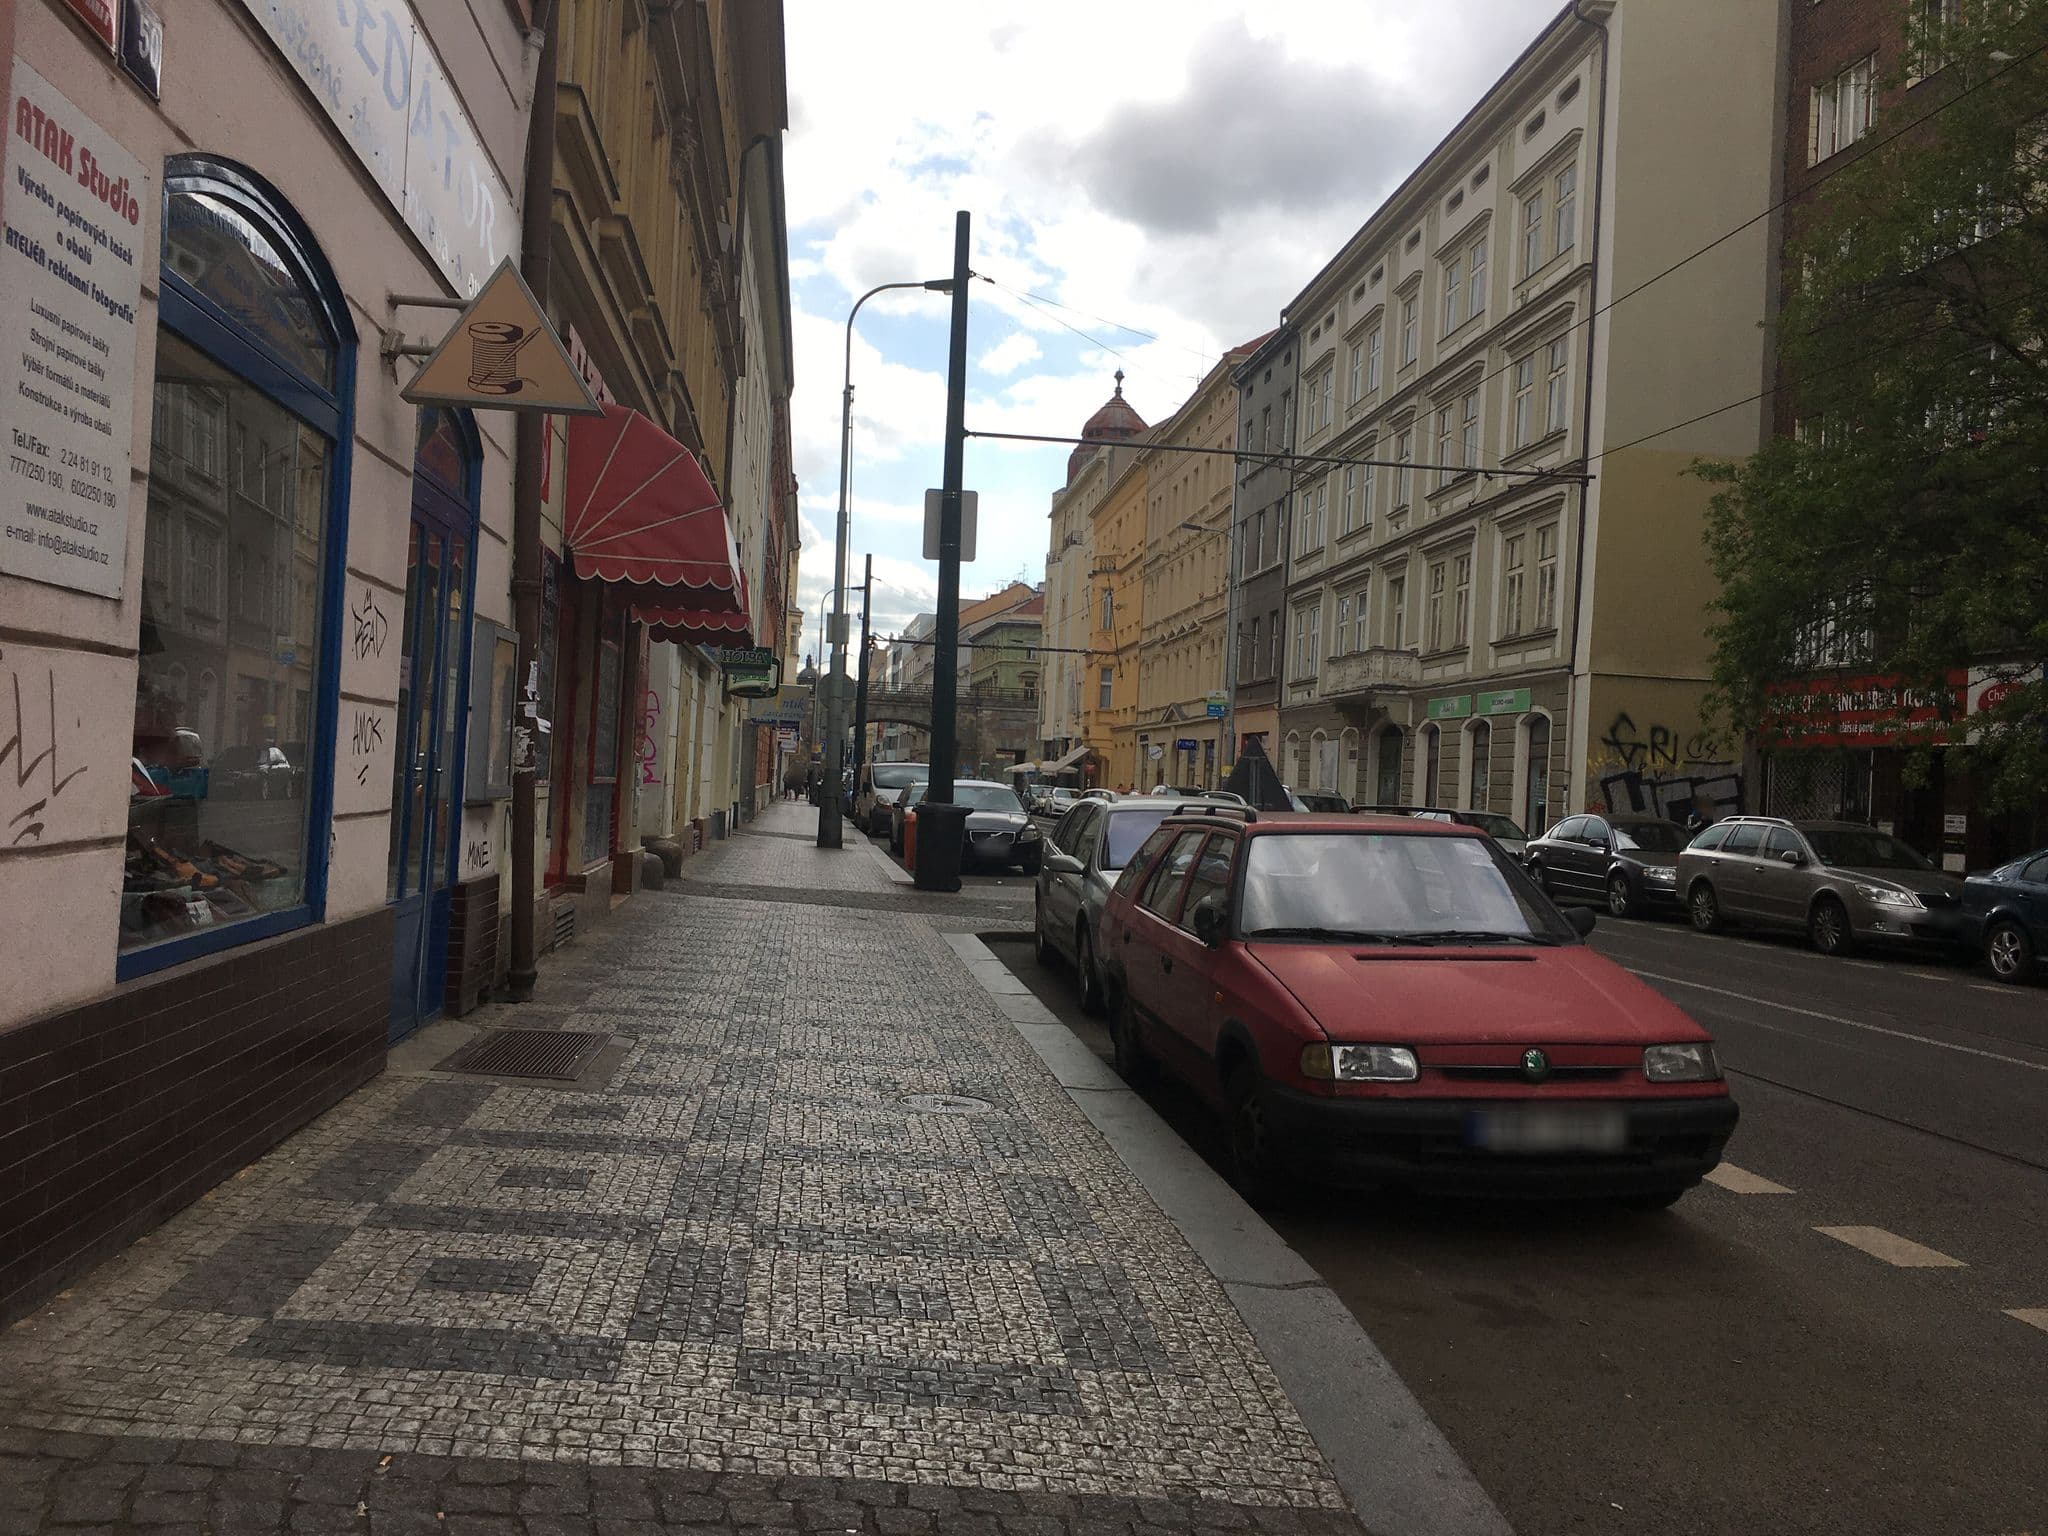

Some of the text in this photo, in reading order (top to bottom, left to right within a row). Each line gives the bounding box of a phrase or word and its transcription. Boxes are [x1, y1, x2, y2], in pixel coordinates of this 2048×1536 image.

[16, 96, 139, 226] ATAK Studio
[18, 165, 133, 266] Výroba papírových tašek
[57, 231, 92, 265] a obalů
[6, 226, 134, 324] ATELIÉR reklamní fotografie
[18, 381, 62, 413] Konstrukce
[63, 405, 68, 416] a
[74, 383, 80, 393] a
[26, 502, 98, 536] www.atakstudio.cz
[38, 529, 109, 565] info@atakstudio.cz
